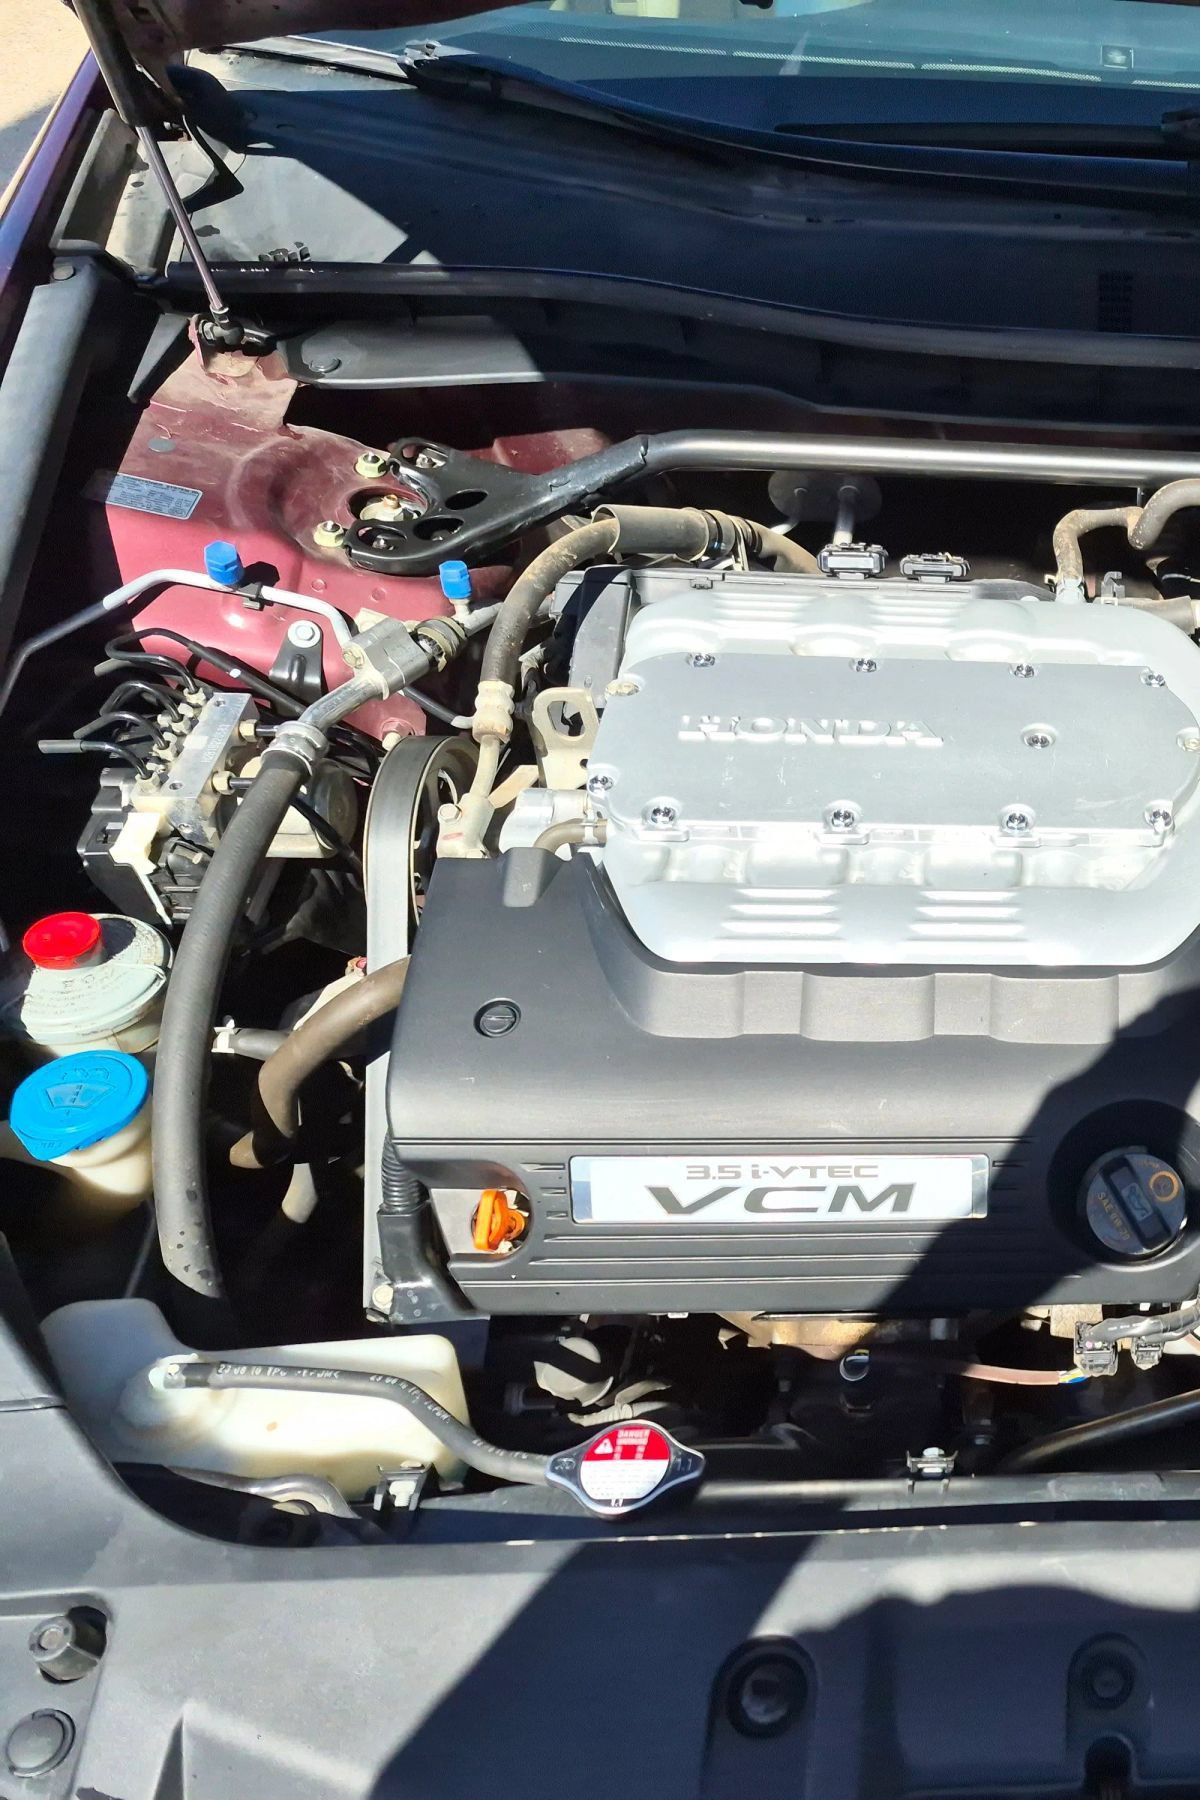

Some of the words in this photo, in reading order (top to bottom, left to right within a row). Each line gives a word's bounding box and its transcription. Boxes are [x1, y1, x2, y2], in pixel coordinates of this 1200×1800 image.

[678, 713, 943, 746] HONDA
[686, 1164, 740, 1180] 3.5
[751, 1164, 879, 1179] i-VTEC
[644, 1182, 917, 1215] VCM
